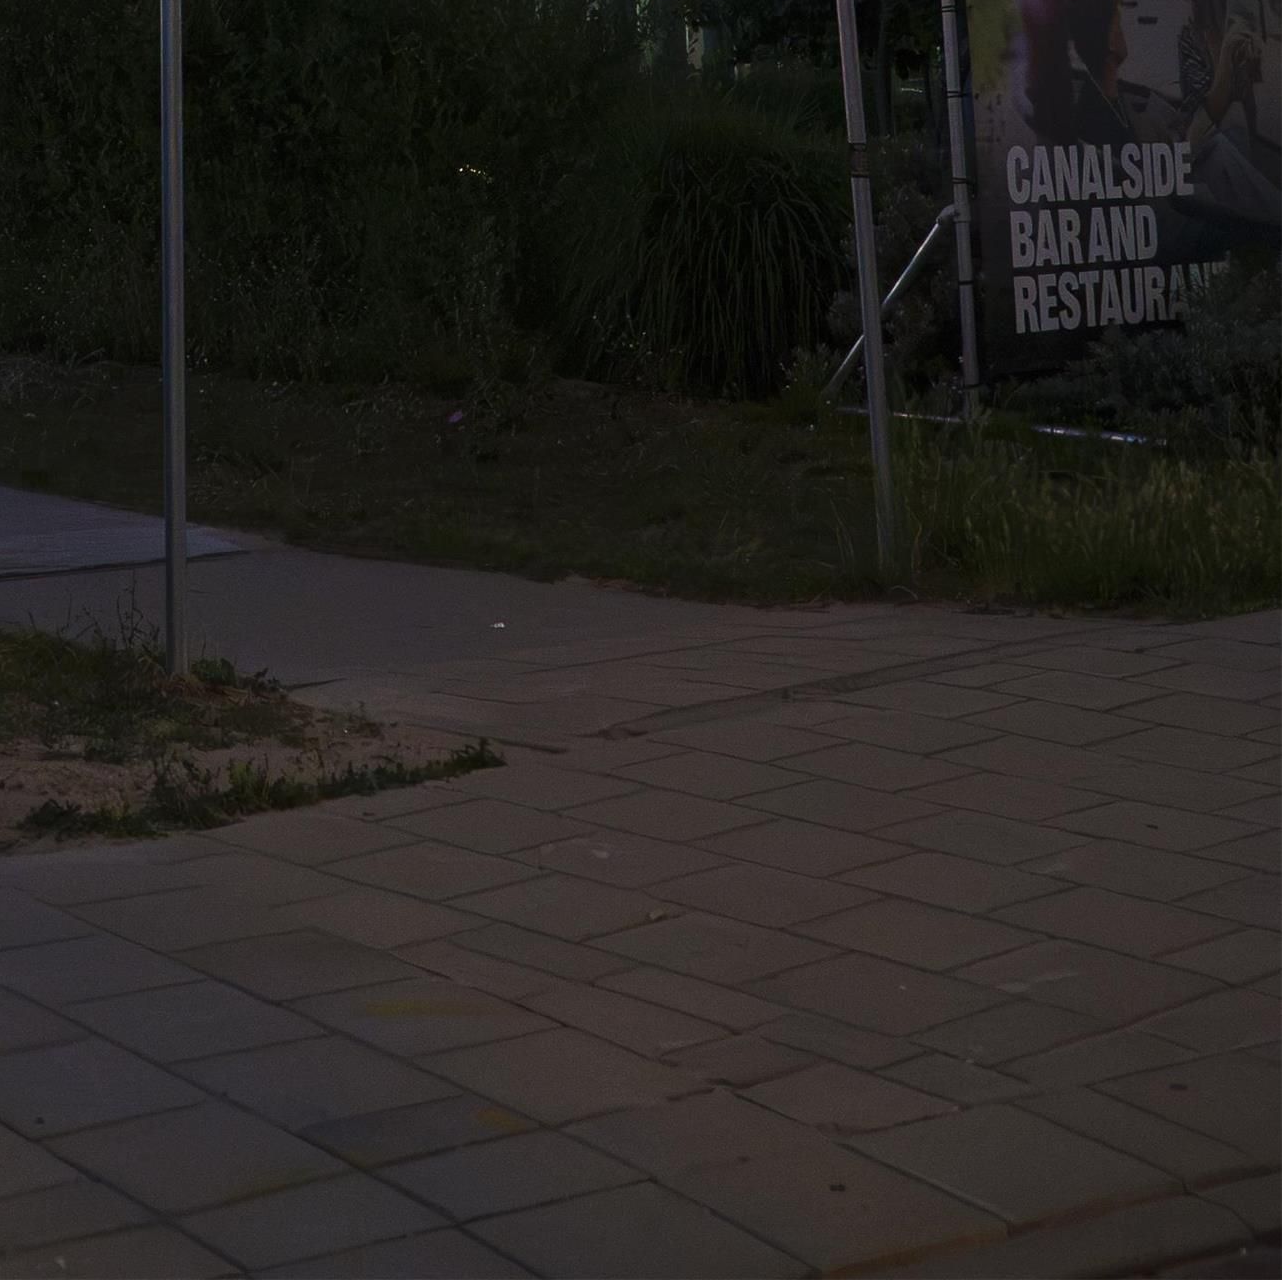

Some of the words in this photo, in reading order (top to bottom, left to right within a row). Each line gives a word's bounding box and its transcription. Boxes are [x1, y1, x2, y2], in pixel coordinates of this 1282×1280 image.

[1006, 141, 1195, 204] CANALSIDE
[1009, 208, 1084, 268] BAR
[1088, 204, 1159, 264] AND
[1013, 257, 1230, 334] RESTAURA
